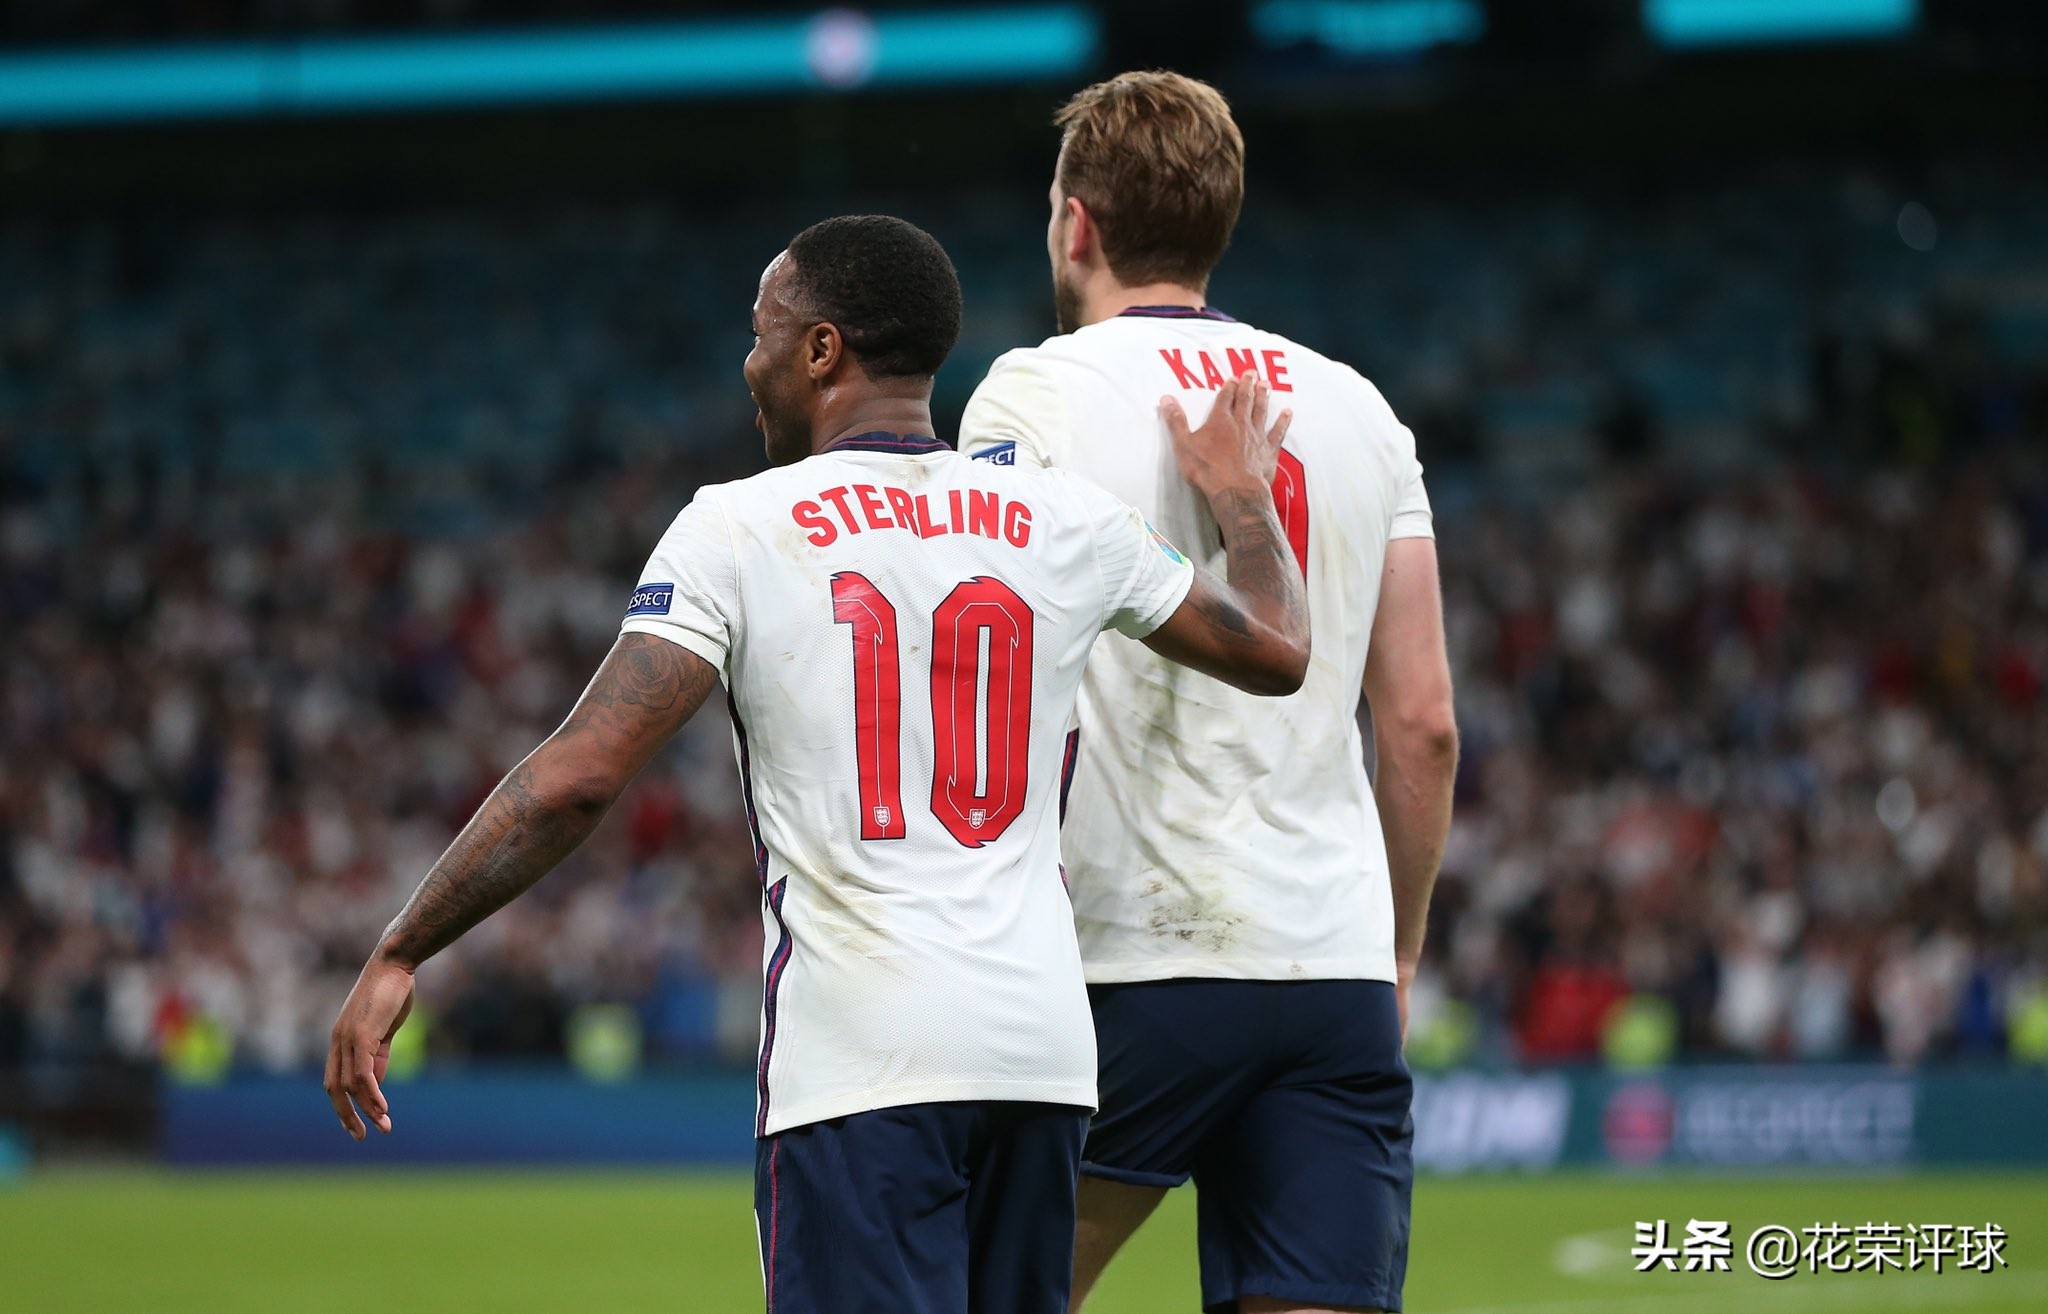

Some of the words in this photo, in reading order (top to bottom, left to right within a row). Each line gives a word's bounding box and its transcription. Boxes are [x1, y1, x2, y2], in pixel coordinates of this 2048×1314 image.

[1159, 348, 1293, 392] KANE
[792, 484, 1032, 548] STERLING
[628, 592, 671, 608] ESPECT
[830, 570, 1034, 848] 10
